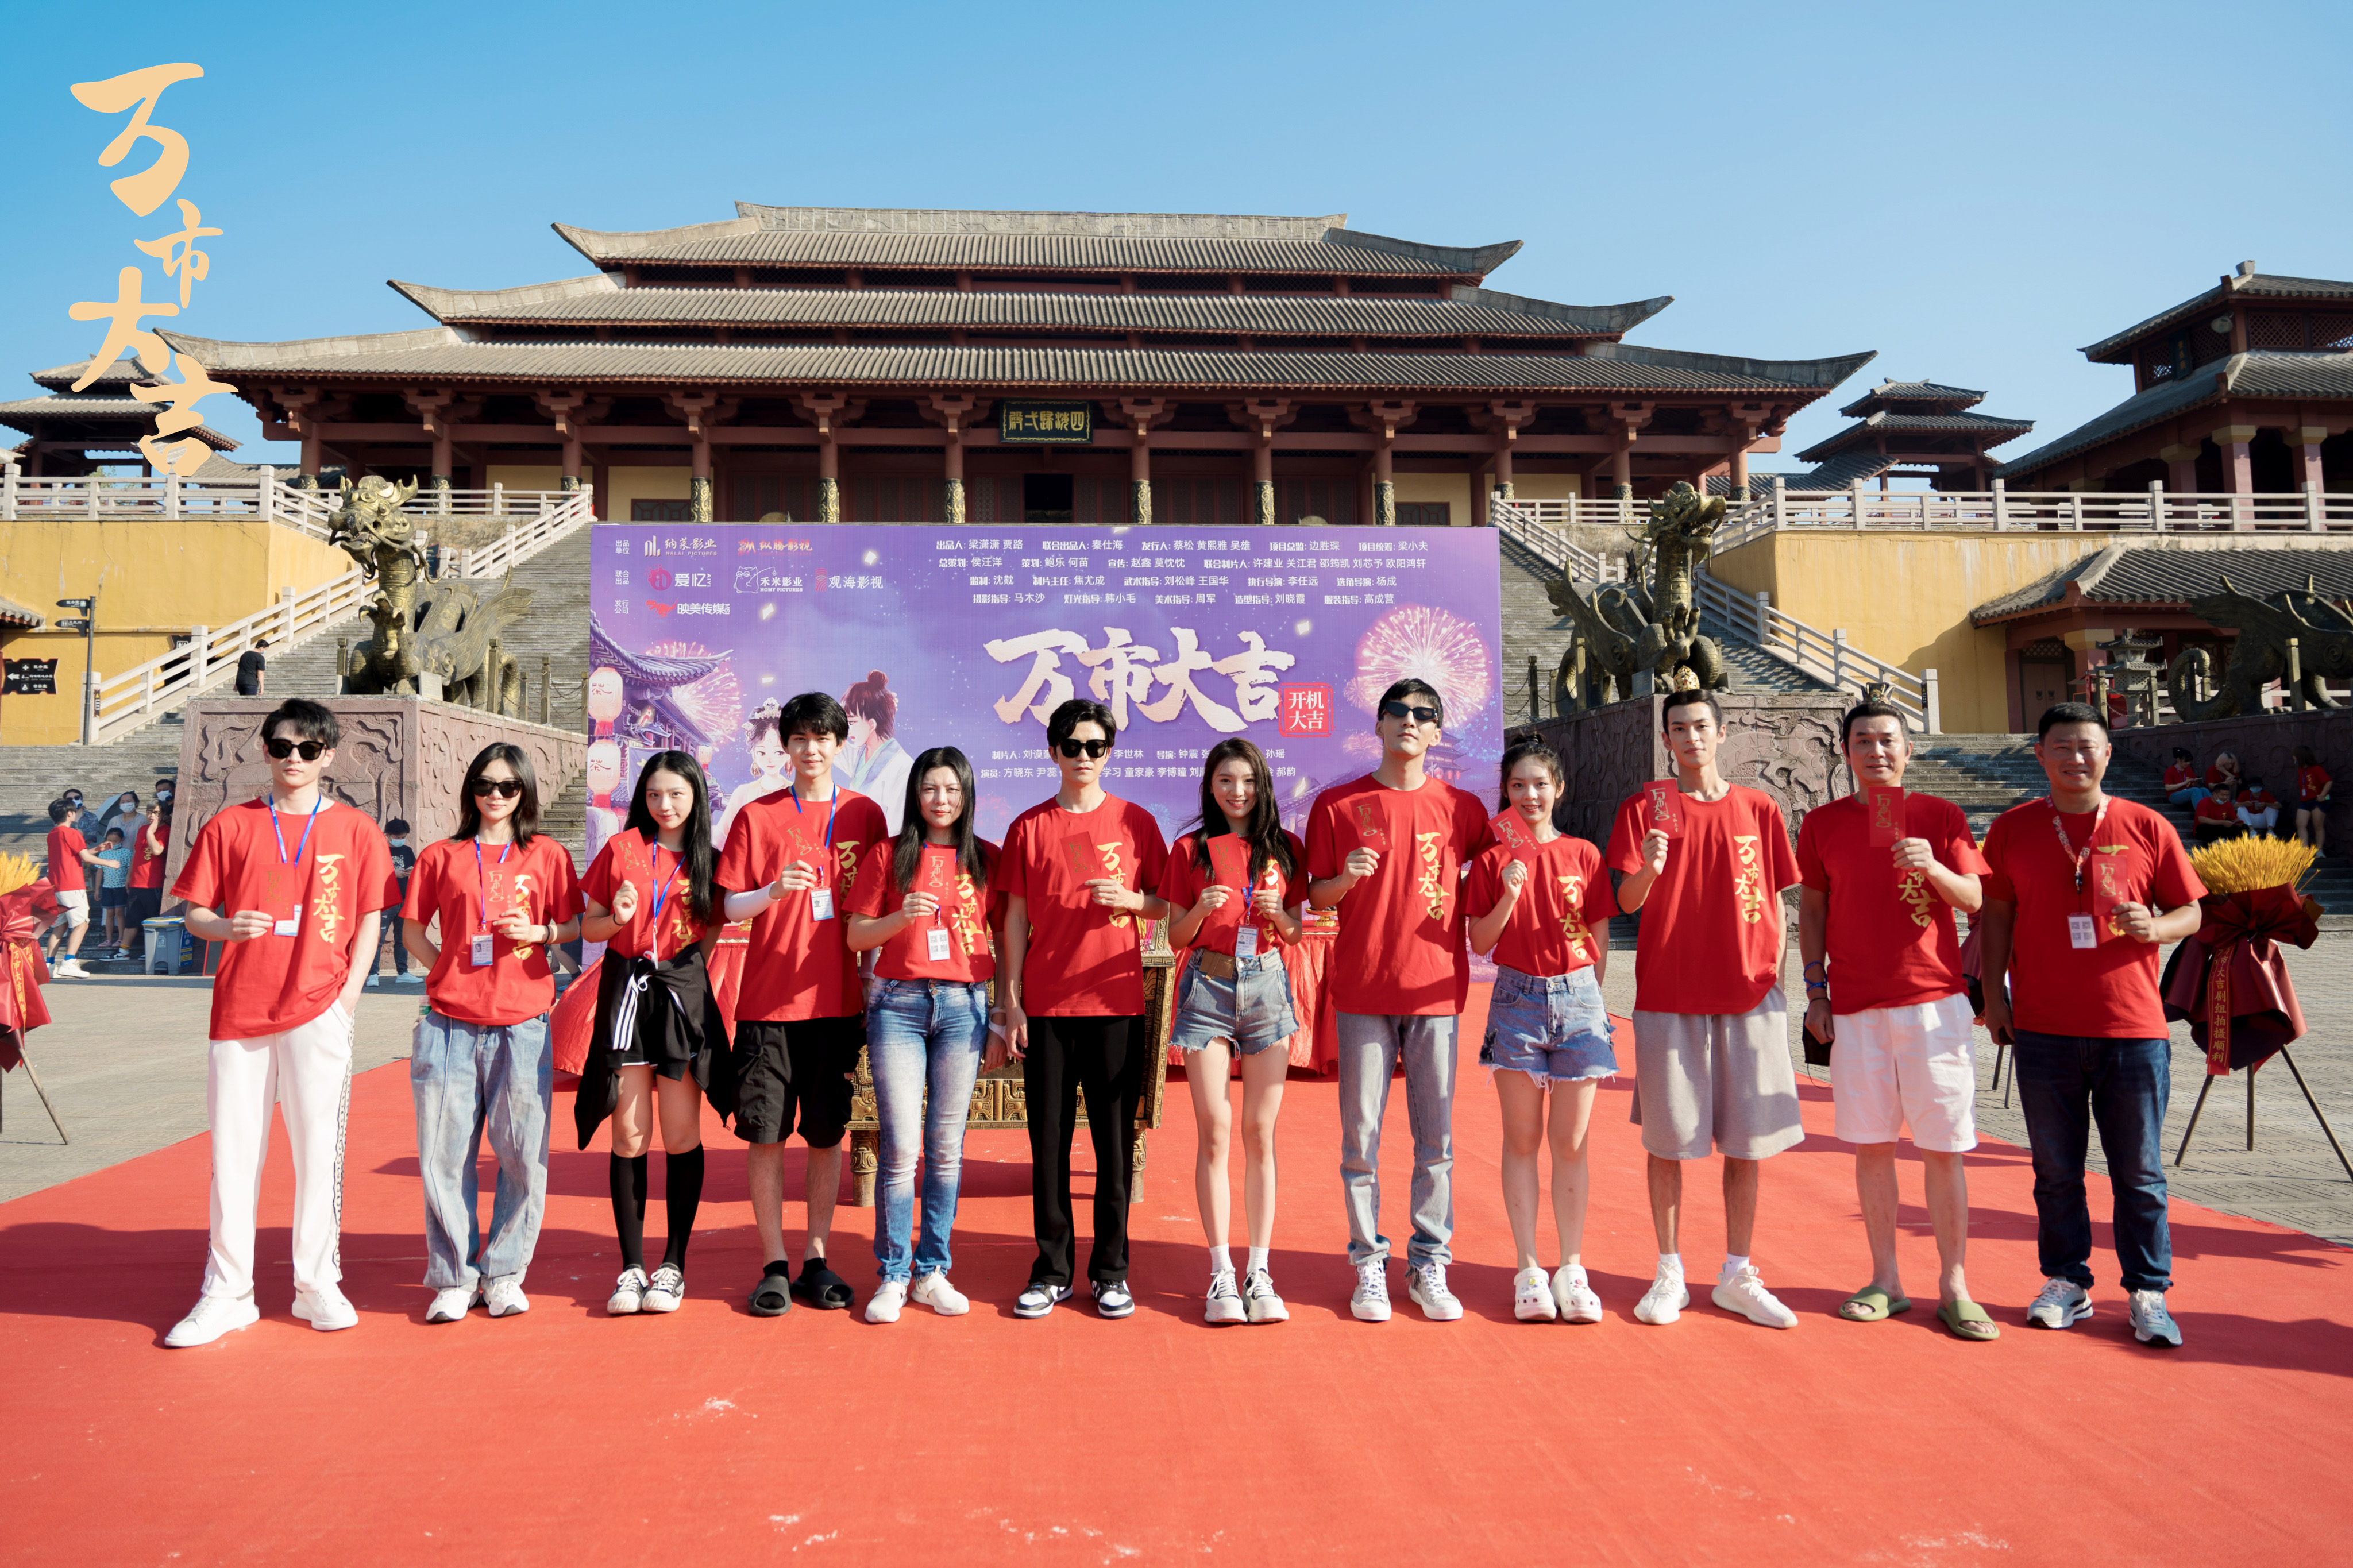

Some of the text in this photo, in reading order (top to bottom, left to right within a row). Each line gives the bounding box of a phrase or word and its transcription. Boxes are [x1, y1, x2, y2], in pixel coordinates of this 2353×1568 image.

[665, 537, 717, 550] 纳莱影业
[969, 539, 1000, 549] 梁潇潇
[1003, 539, 1023, 549] 贾路
[1092, 540, 1123, 550] 秦仕海
[1174, 540, 1194, 550] 蔡松
[1197, 540, 1227, 550] 黄熙雅
[1230, 540, 1250, 550] 吴雄
[1310, 541, 1340, 550] 边胜琛
[1398, 541, 1428, 551] 梁小夫
[971, 557, 1002, 567] 侯汪洋
[1045, 556, 1065, 567] 鲍乐
[1068, 557, 1088, 567] 何苗
[1131, 557, 1151, 567] 赵鑫
[1155, 558, 1185, 567] 莫忱忱
[1253, 558, 1283, 568] 许建业
[1287, 558, 1316, 568] 关江君
[1320, 558, 1350, 568] 邵筠凯
[1353, 558, 1383, 568] 刘芯予
[1386, 558, 1426, 568] 欧阳鸿轩
[675, 573, 707, 586] 爱忆
[760, 576, 803, 588] 禾米影业
[828, 576, 883, 589] 观海影视
[1074, 575, 1105, 585] 焦尤成
[1164, 576, 1195, 585] 刘松峰
[1198, 576, 1228, 586] 王国华
[1288, 576, 1318, 586] 李任远
[1376, 576, 1397, 586] 杨成
[1015, 593, 1045, 603] 马木沙
[1104, 593, 1136, 603] 韩小毛
[1196, 594, 1216, 603] 周军
[1275, 594, 1305, 604] 刘晓霞
[1364, 594, 1394, 604] 高成营
[677, 602, 724, 615] 映美传媒
[983, 627, 1295, 732] 万市大吉
[1289, 691, 1324, 710] 开机
[1289, 711, 1323, 729] 大吉
[1113, 749, 1144, 759] 李世林
[1178, 748, 1199, 759] 钟震
[1266, 748, 1286, 759] 孙瑶
[1003, 767, 1033, 778] 方晓东
[1036, 767, 1058, 778] 尹蕊
[1124, 767, 1154, 777] 童家豪
[1157, 767, 1187, 777] 李博瞳
[1276, 766, 1296, 777] 郝韵
[1416, 832, 1451, 921] 万市大吉
[1734, 835, 1766, 924] 万市大吉
[313, 853, 345, 943] 万市大吉
[952, 874, 984, 957] 万市大吉
